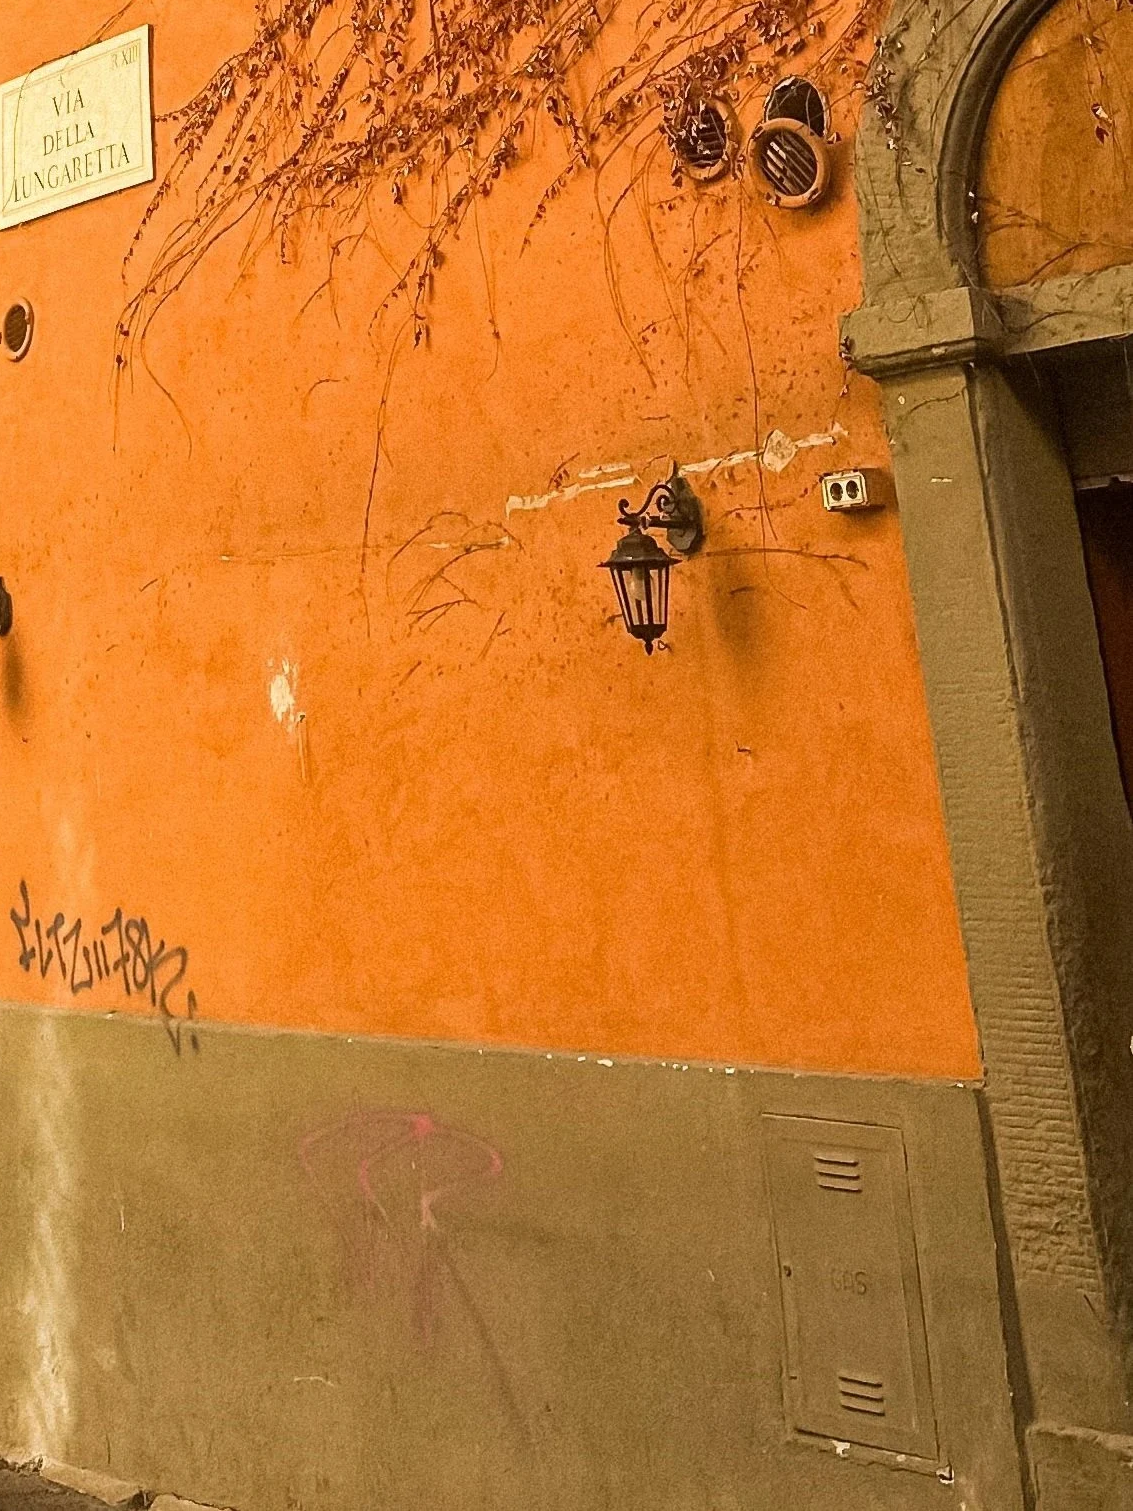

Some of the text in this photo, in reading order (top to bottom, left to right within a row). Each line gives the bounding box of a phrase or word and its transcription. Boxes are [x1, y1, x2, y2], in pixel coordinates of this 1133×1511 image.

[52, 88, 85, 117] VIA
[43, 120, 95, 156] DELLA
[14, 142, 130, 202] LUNGARETTA
